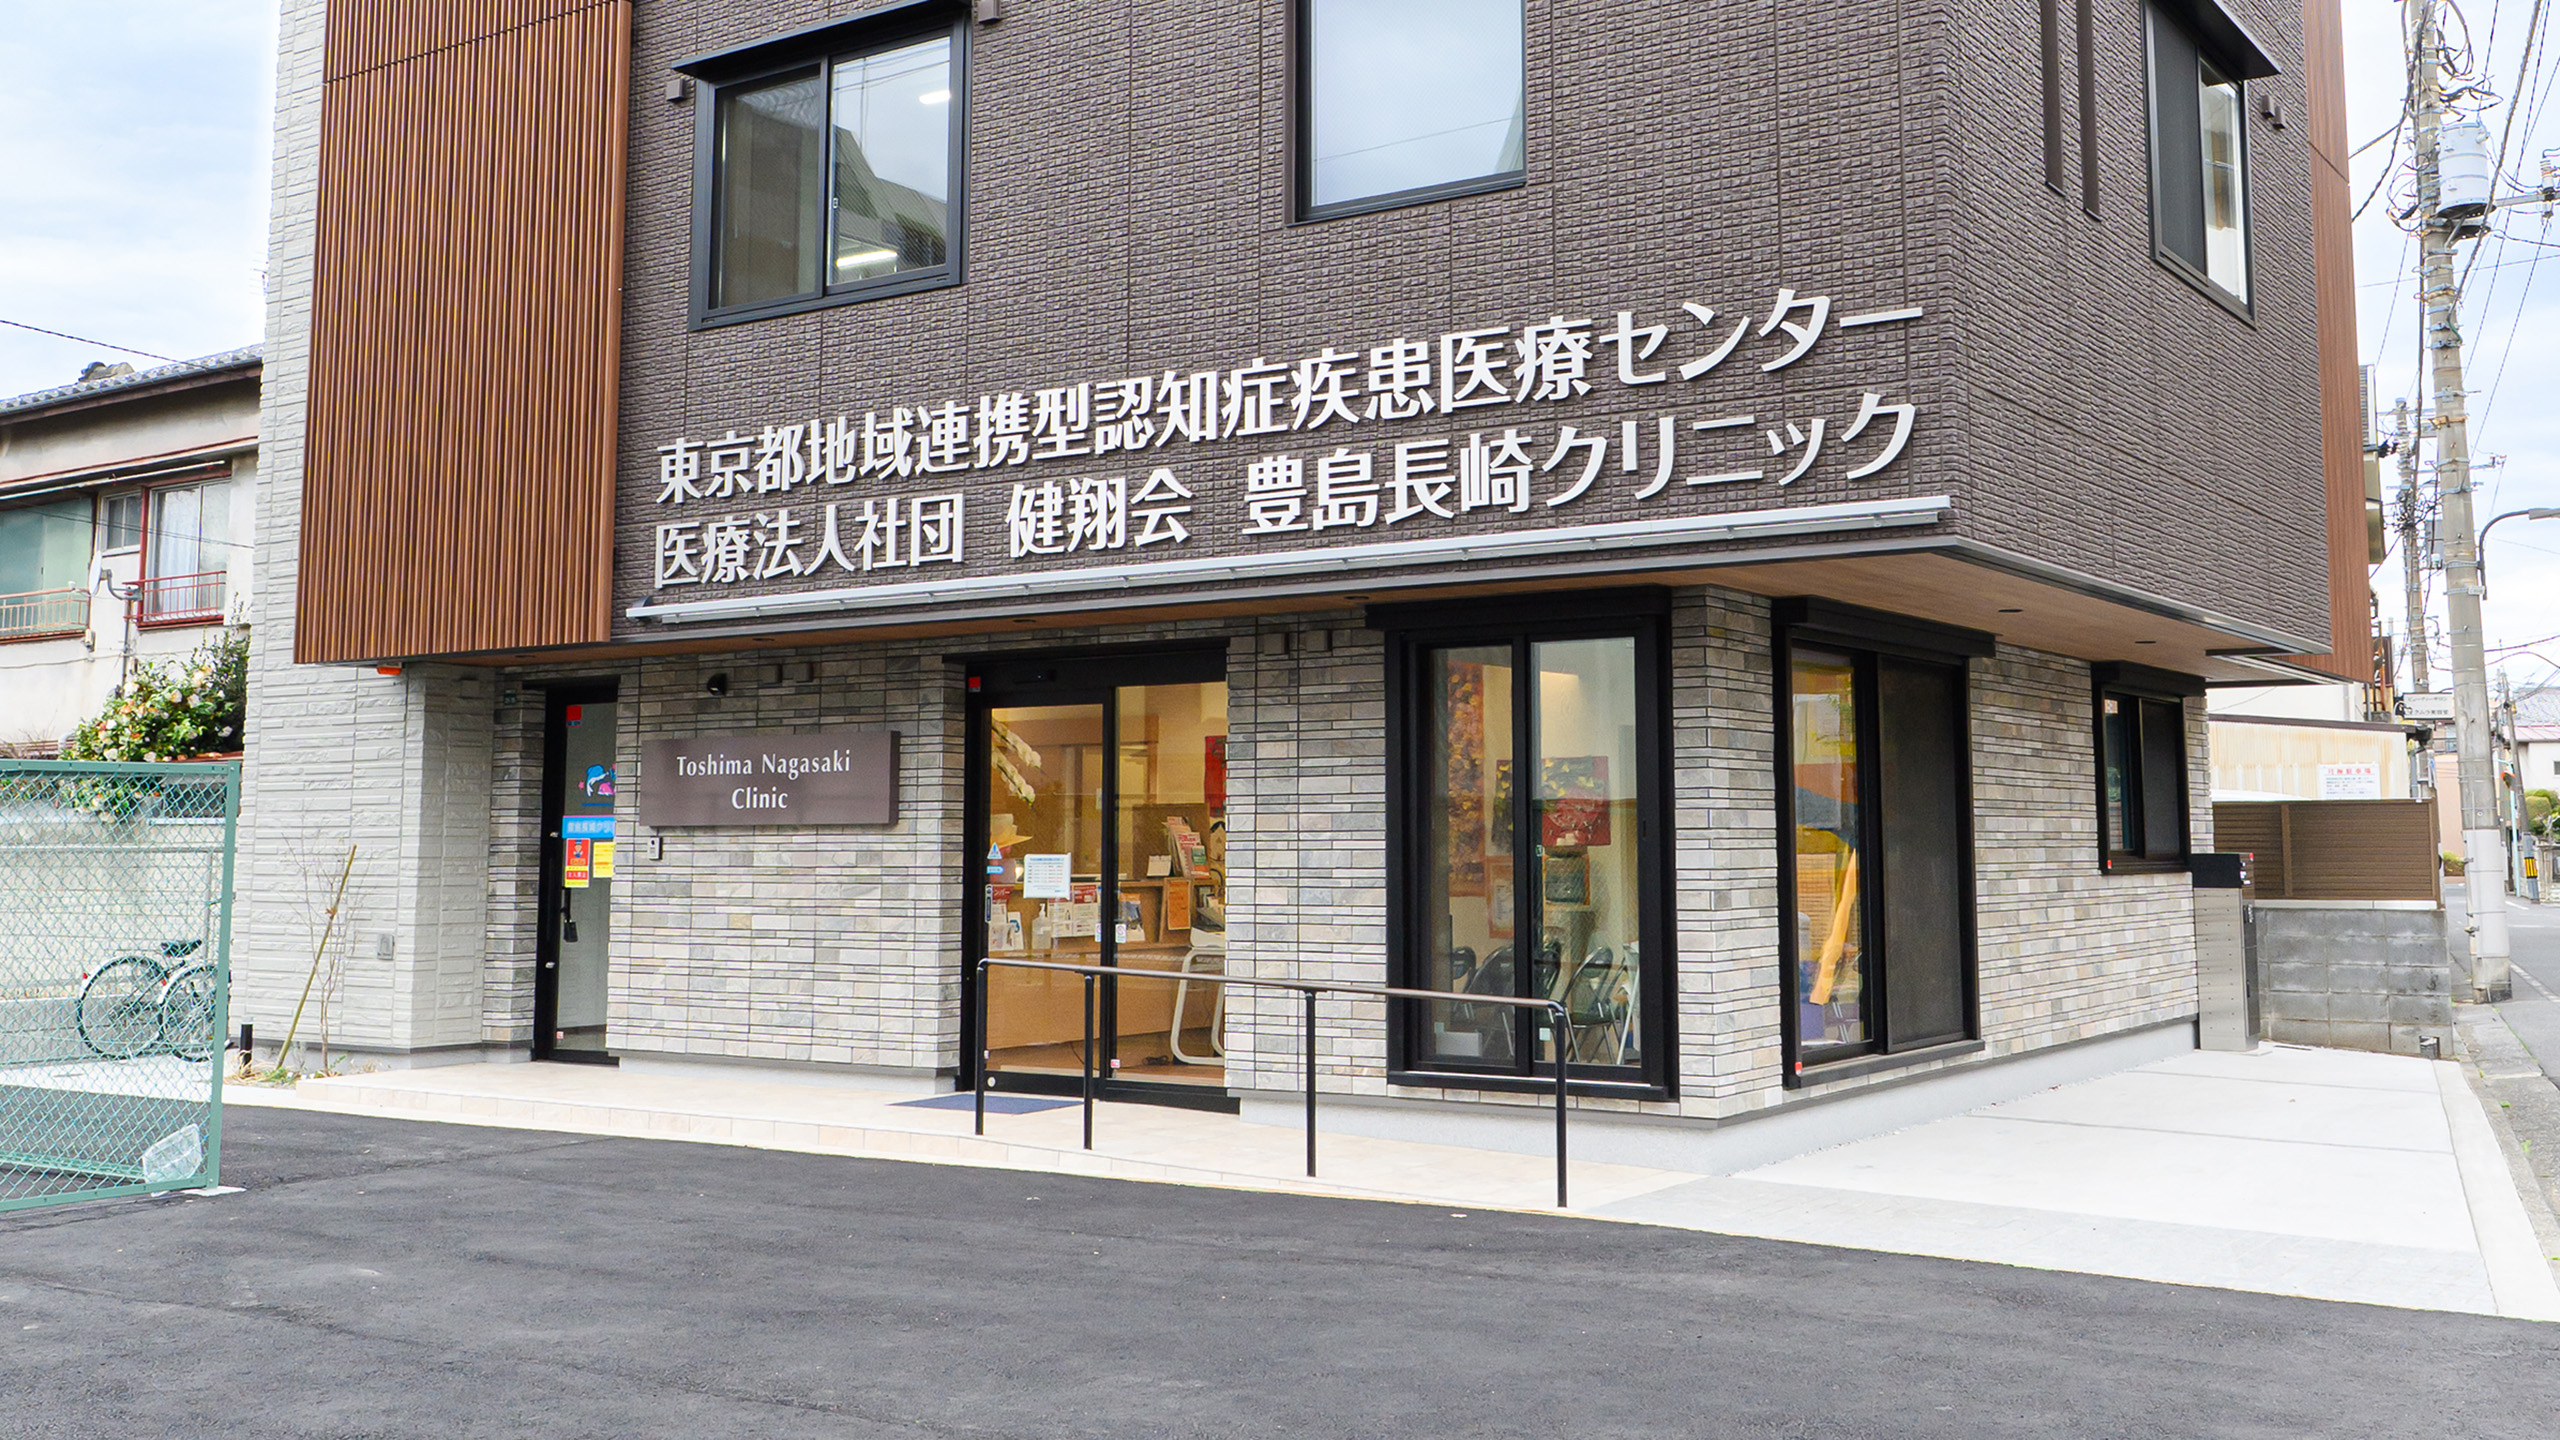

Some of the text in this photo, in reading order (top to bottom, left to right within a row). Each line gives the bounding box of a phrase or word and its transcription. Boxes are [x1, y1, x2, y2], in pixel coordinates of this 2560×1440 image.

[657, 288, 1924, 504] 東京都地域連携型認知症疾患医療センター
[653, 392, 1917, 589] 医療法人社団 健翔会 豊島長崎クリニック
[677, 749, 852, 780] Toshima Nagasaki
[731, 786, 789, 810] Clinic
